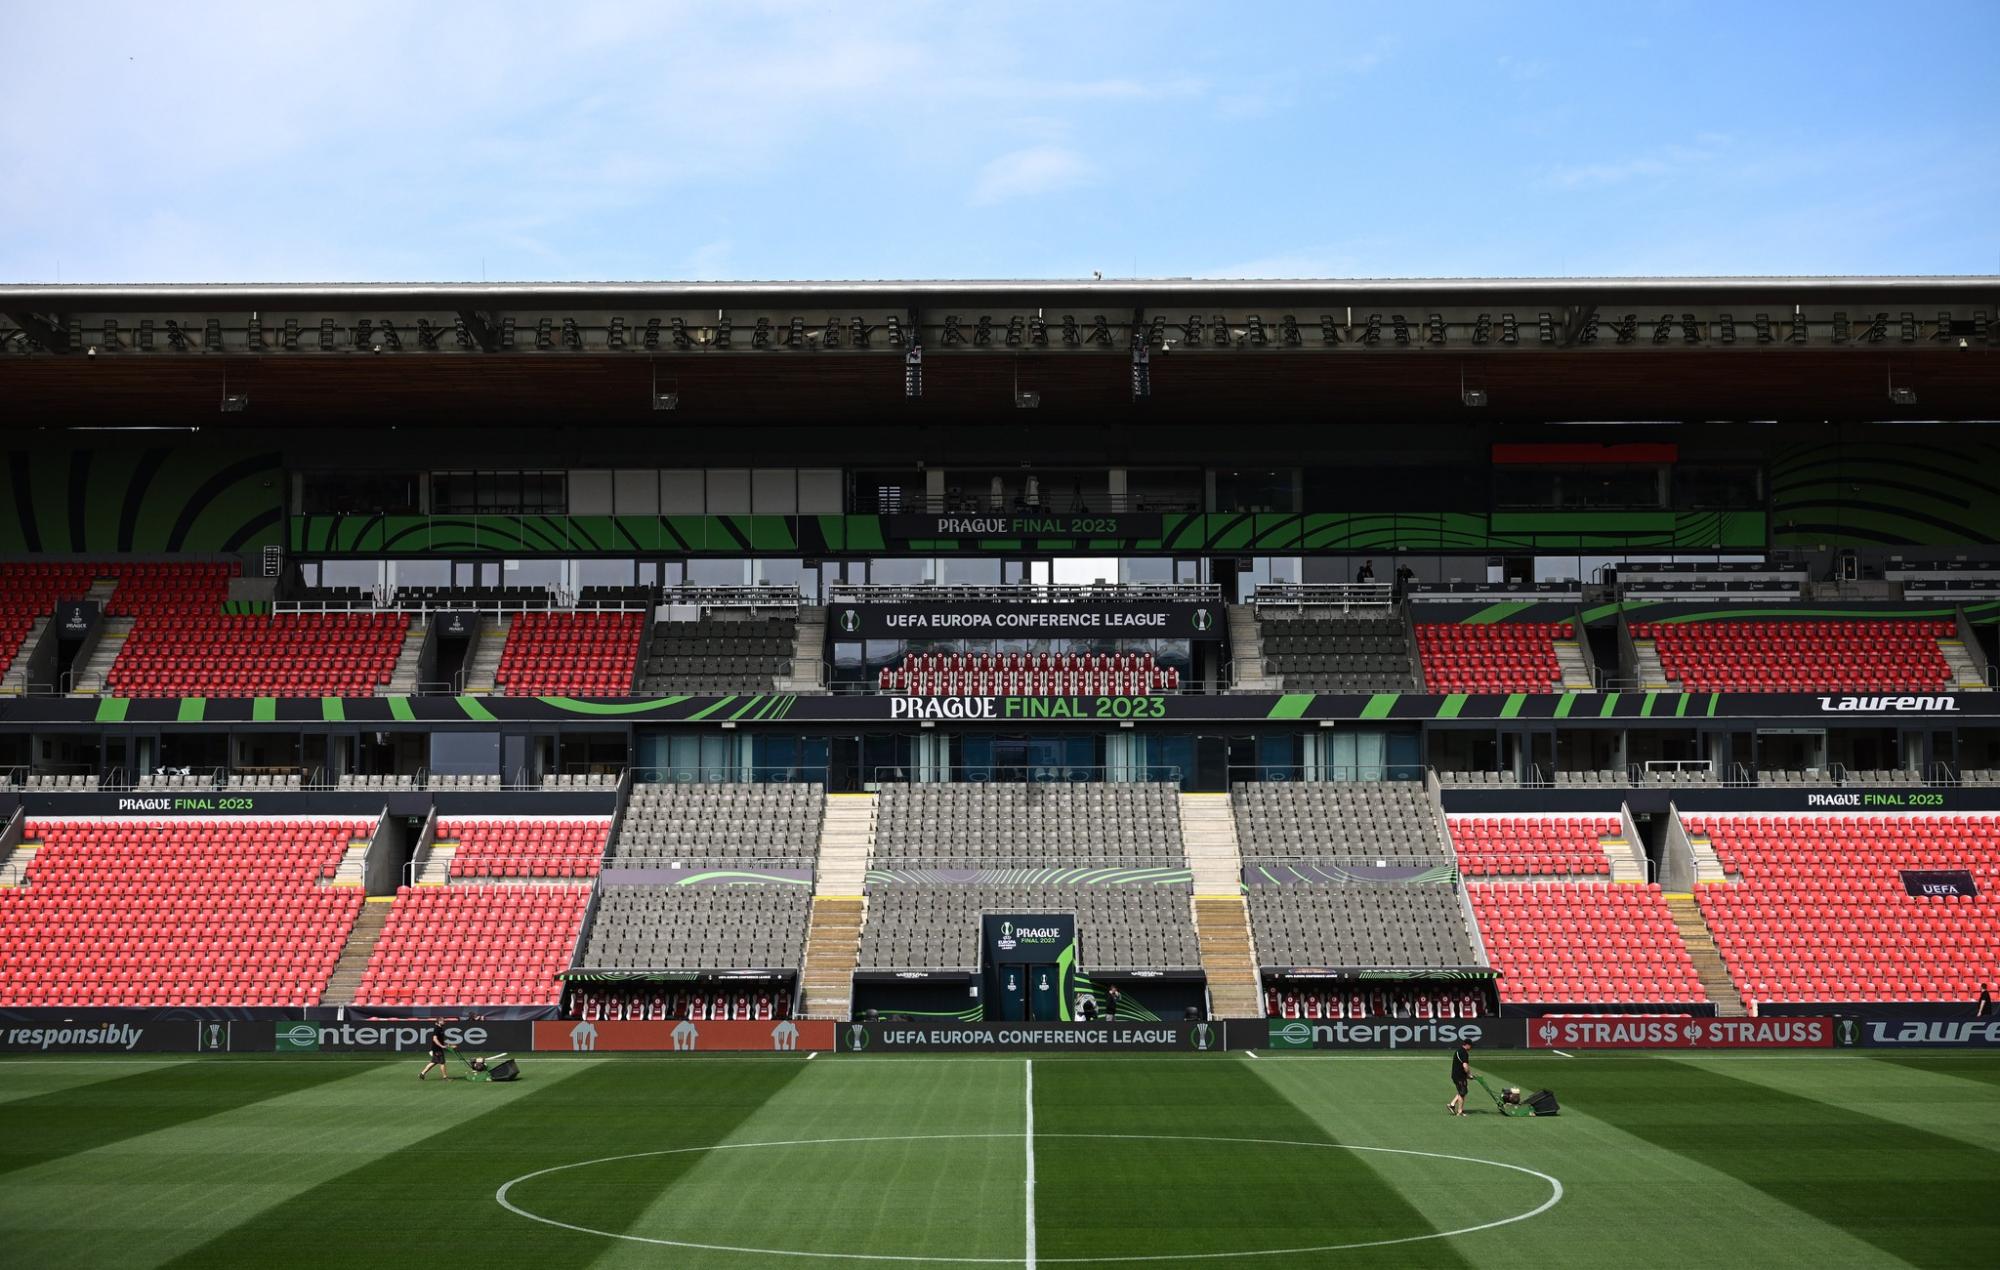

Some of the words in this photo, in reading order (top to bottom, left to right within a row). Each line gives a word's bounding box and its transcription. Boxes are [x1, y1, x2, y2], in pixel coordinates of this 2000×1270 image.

[938, 519, 1007, 533] PRAGUE
[1012, 519, 1067, 533] FINAL
[1071, 519, 1117, 533] 2023
[886, 615, 928, 627] UEFA
[931, 614, 993, 627] EUROPA
[996, 614, 1100, 626] CONFERENCE
[890, 697, 997, 718] PRAGUE
[1005, 697, 1088, 718] FINAL
[1095, 697, 1166, 718] 2023
[118, 798, 171, 810] PRAGUE
[174, 799, 215, 810] FINAL
[219, 798, 254, 810] 2023
[1808, 794, 1861, 806] PRAGUE
[1864, 794, 1906, 805] FINAL
[1908, 794, 1944, 805] 2023
[1922, 884, 1959, 894] UEFA
[1016, 928, 1061, 938] PRAGUE
[8, 1022, 143, 1050] responsibly
[276, 1023, 488, 1051] enterprse
[883, 1031, 927, 1044] UEFA
[931, 1031, 995, 1044] EUROPA
[998, 1030, 1108, 1043] CONFERENCE
[1113, 1030, 1177, 1043] LEAGUE
[1269, 1019, 1483, 1048] enterprise
[1564, 1023, 1678, 1043] STRAUSS
[1708, 1022, 1823, 1042] STRAUSS
